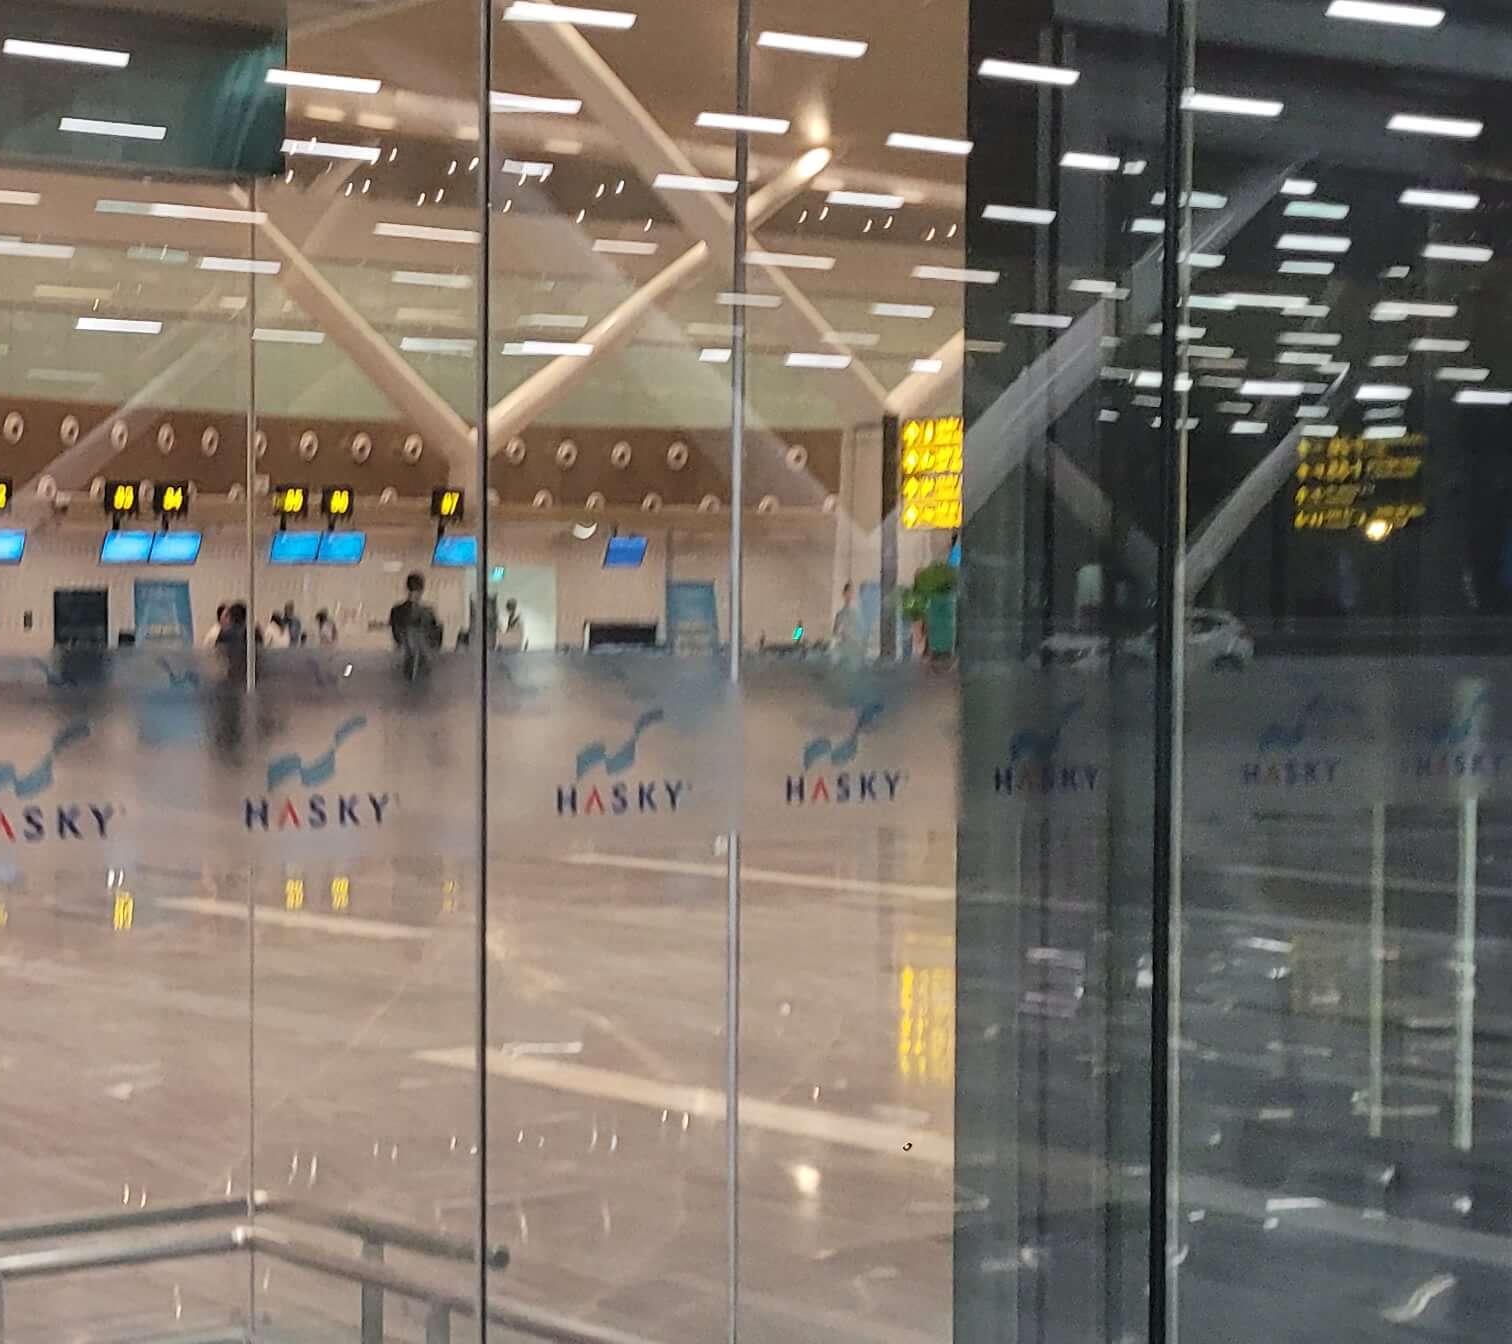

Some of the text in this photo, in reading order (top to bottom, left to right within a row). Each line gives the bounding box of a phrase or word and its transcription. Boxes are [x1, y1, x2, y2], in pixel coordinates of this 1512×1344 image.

[556, 779, 683, 818] HASKY
[785, 770, 901, 805] HASKY
[244, 792, 389, 832] HASKY
